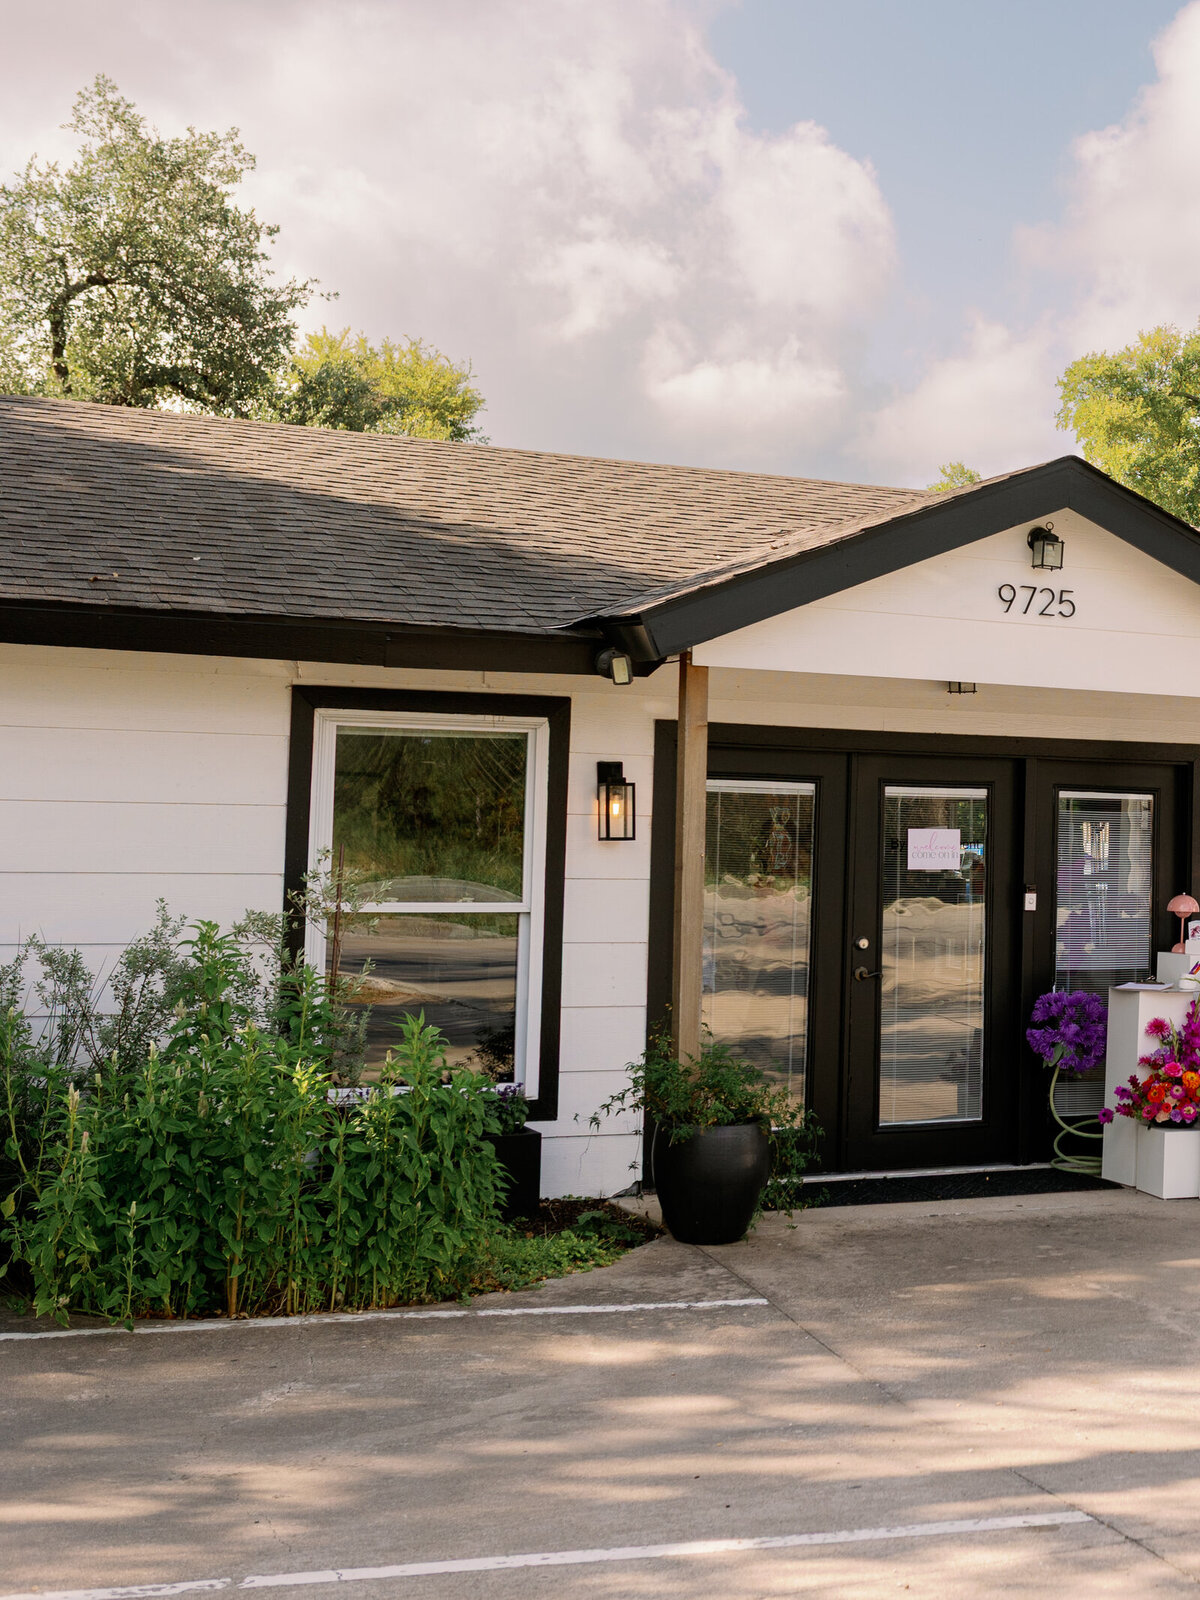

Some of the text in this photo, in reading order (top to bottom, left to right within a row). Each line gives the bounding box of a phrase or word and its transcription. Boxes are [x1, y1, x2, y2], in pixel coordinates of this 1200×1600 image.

[998, 583, 1076, 618] 9725
[913, 831, 957, 851] welcome
[911, 851, 959, 859] come on in
